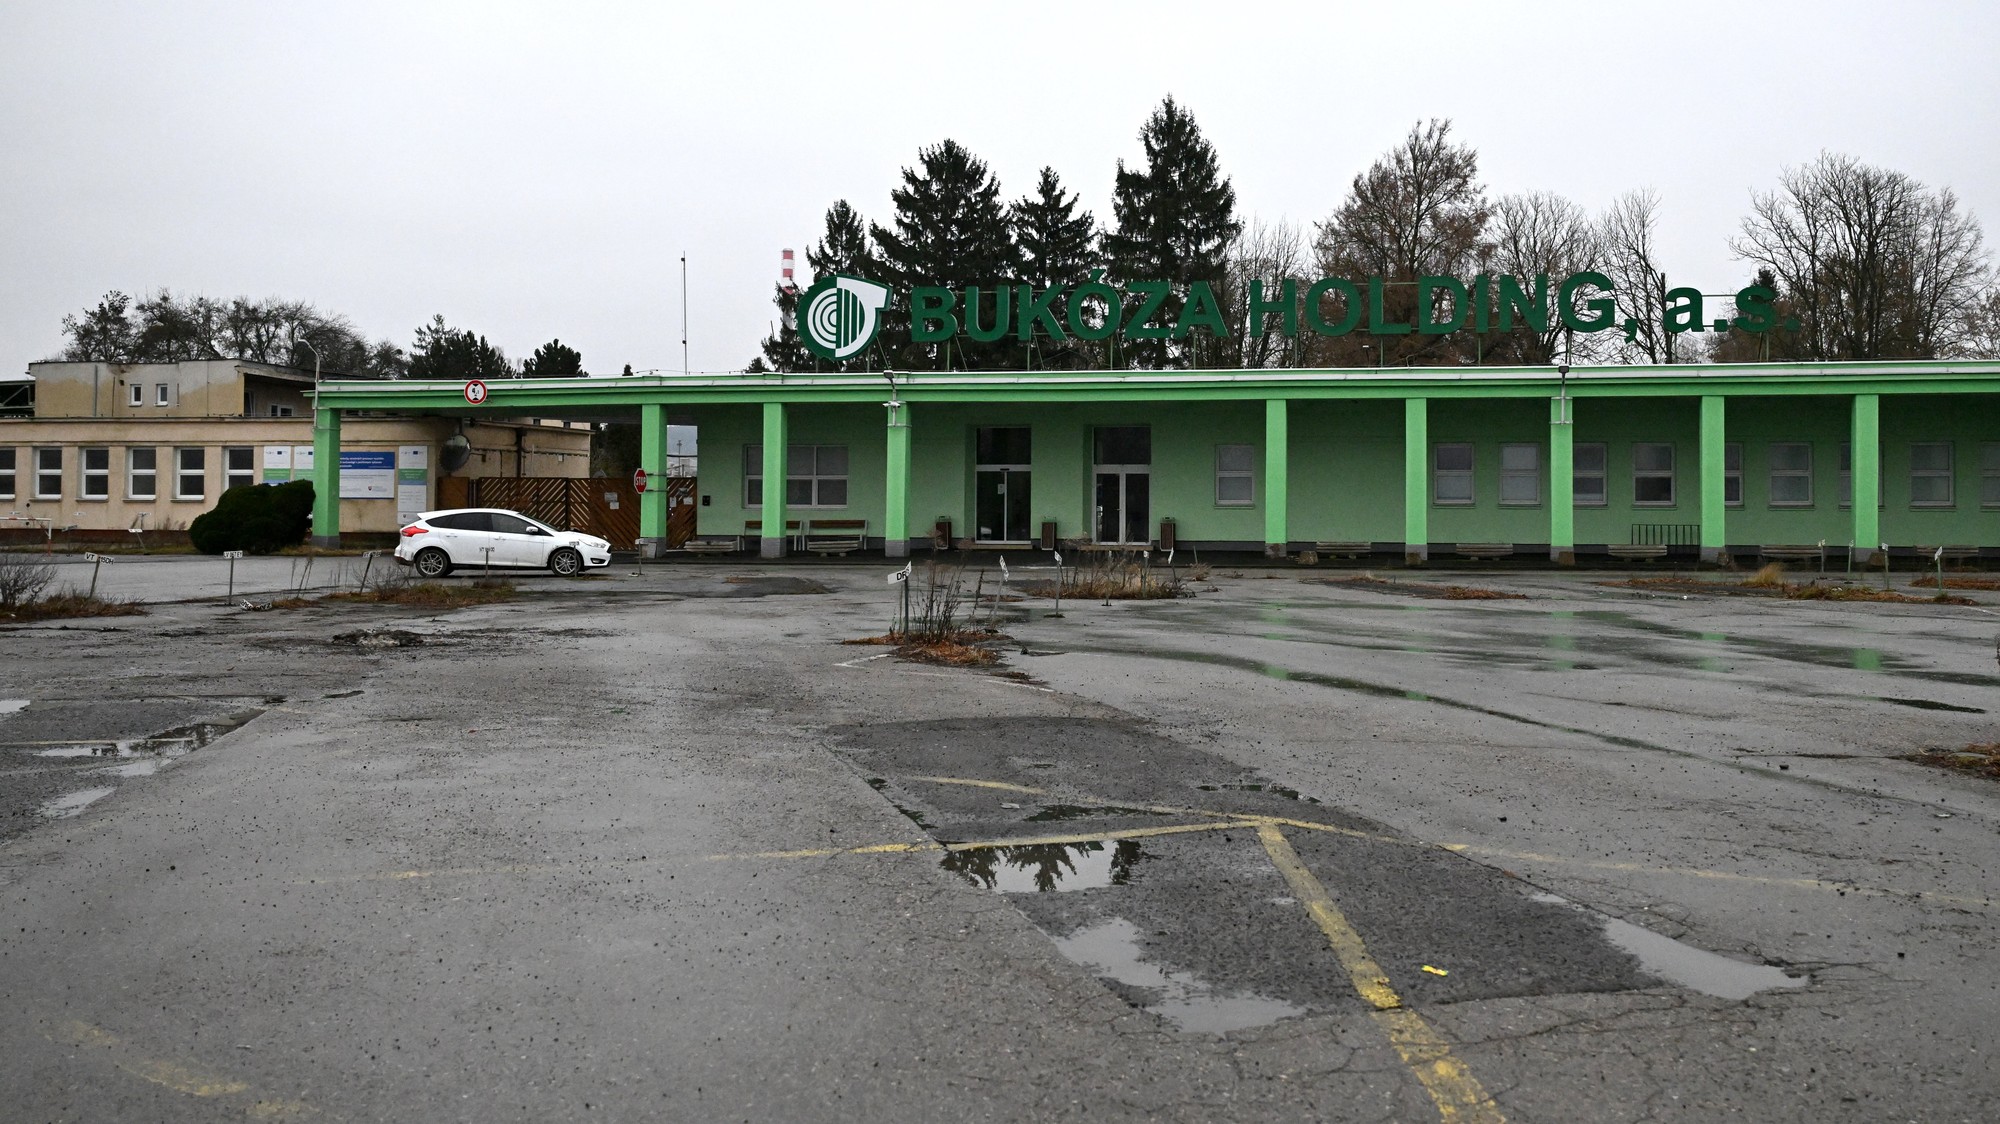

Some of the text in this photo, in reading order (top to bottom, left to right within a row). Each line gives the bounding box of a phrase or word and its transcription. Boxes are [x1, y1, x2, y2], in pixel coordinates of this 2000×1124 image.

[911, 269, 1801, 344] BUKÓZA HOLDING, a.s.
[635, 476, 646, 486] STOP
